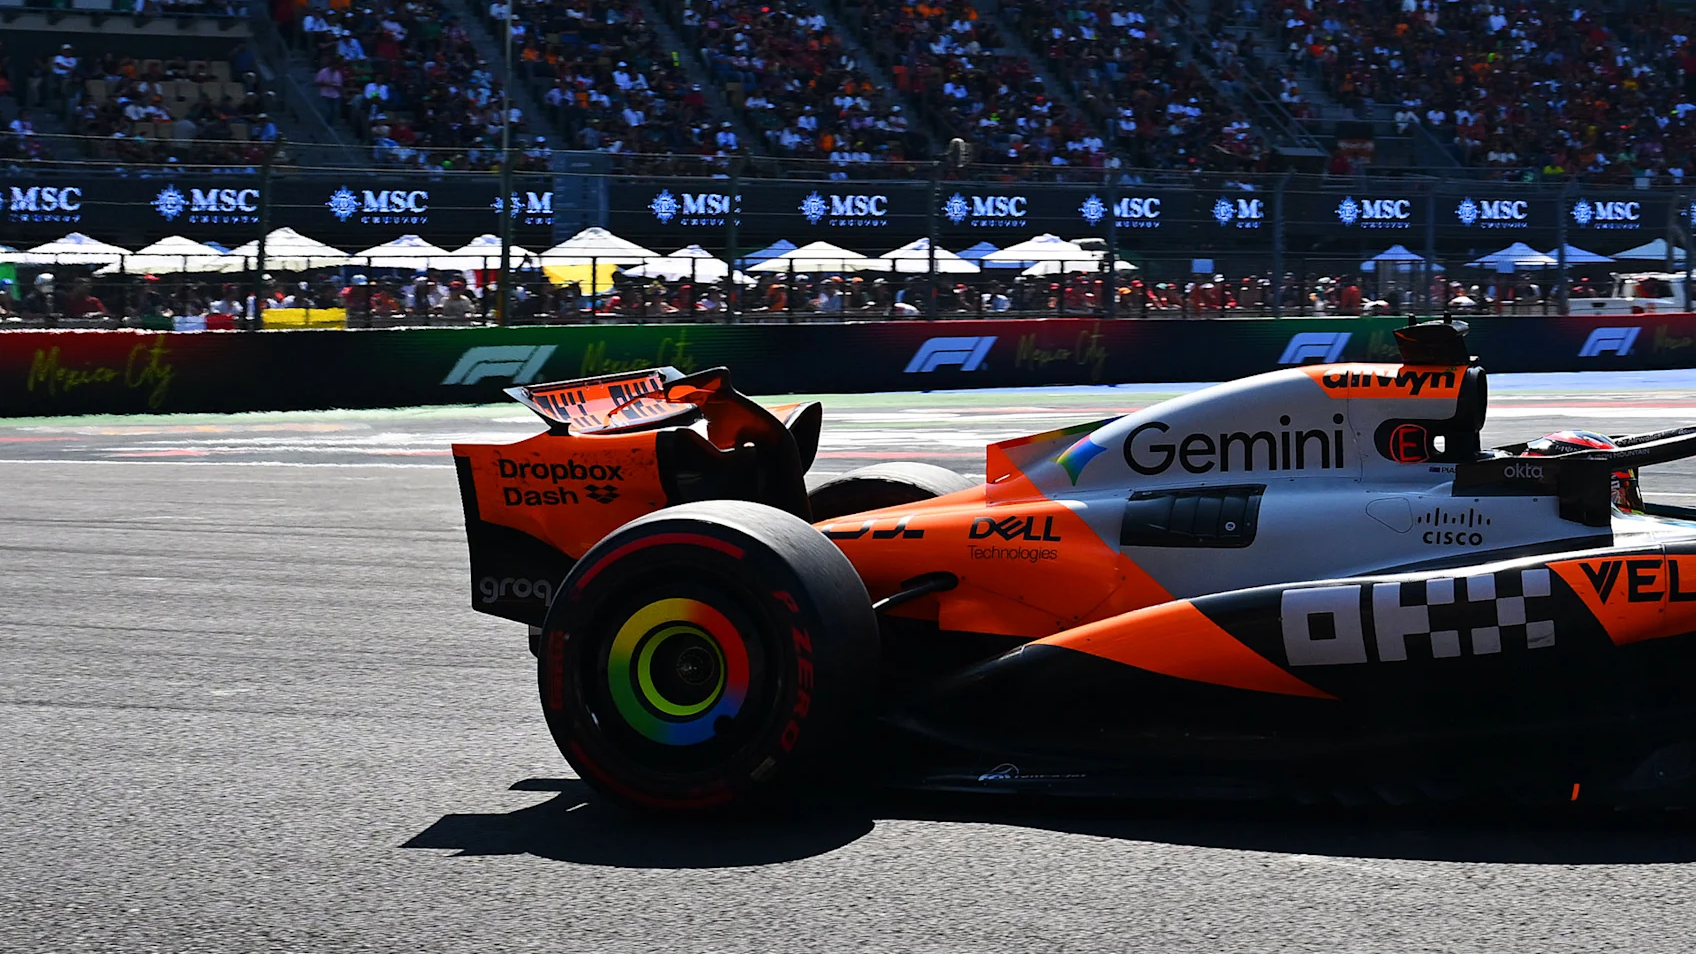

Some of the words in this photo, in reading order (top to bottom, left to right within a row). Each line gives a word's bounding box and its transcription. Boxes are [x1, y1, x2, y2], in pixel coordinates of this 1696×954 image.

[10, 187, 81, 211] MSC
[191, 189, 259, 211] MSC
[362, 190, 428, 212] MSC
[830, 195, 887, 216] MSC
[972, 196, 1026, 217] MSC
[1362, 200, 1410, 219] MSC
[1480, 201, 1527, 219] MSC
[1594, 202, 1640, 220] MSC
[1277, 331, 1352, 365] F1
[1578, 326, 1642, 357] F1
[442, 345, 558, 385] F1
[904, 336, 999, 373] F1
[28, 346, 117, 392] Mexico
[1123, 413, 1344, 476] Gemini
[499, 458, 625, 483] Dropbox
[1504, 463, 1543, 479] okta
[504, 486, 578, 507] Dash
[968, 516, 1061, 542] DELL
[1423, 531, 1483, 546] CISCO
[968, 545, 1058, 562] Technologies
[479, 576, 553, 607] groq
[771, 590, 799, 615] P
[780, 627, 814, 751] ZERO
